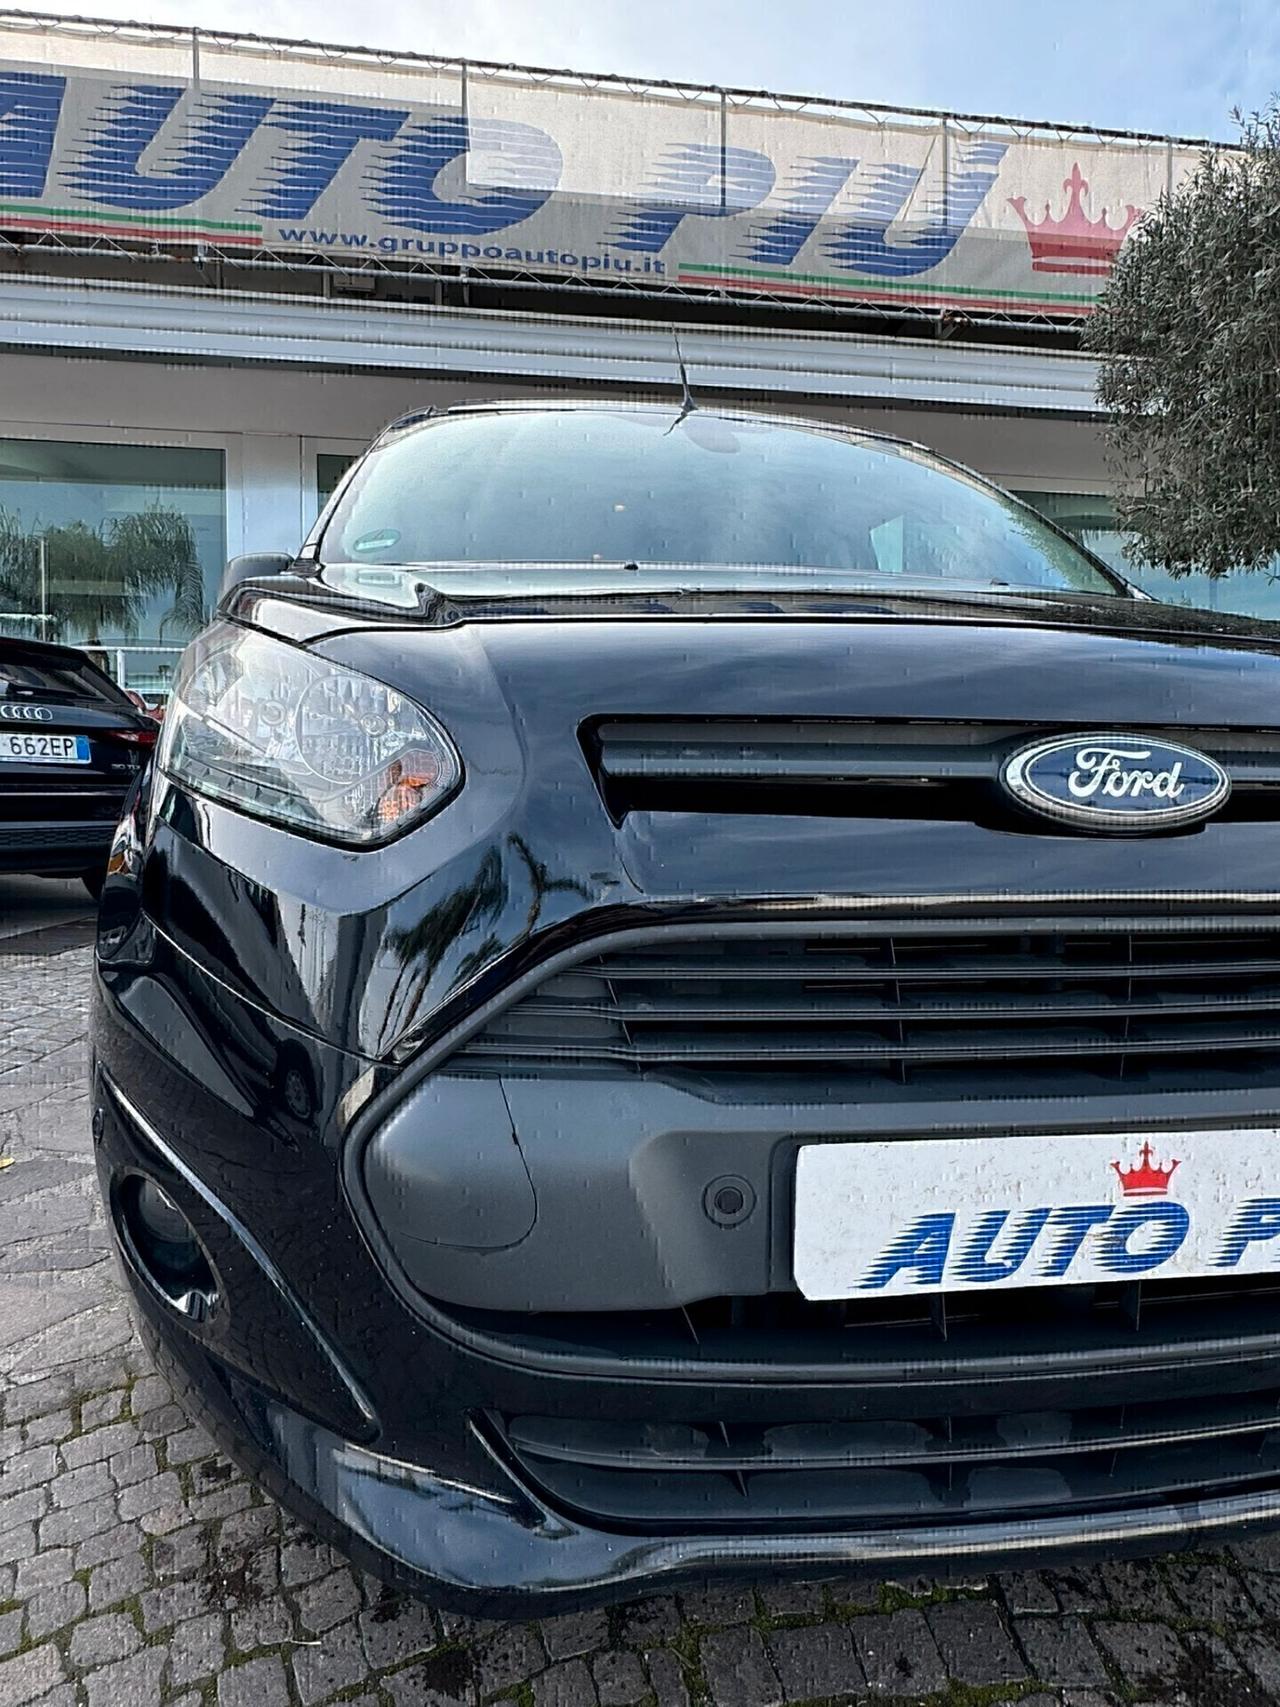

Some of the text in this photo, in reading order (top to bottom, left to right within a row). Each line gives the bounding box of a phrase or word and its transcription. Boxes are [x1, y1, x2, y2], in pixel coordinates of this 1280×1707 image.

[279, 228, 665, 274] www.gruppoautopiu.it
[10, 736, 74, 756] 662EP
[1068, 747, 1184, 798] Ford
[847, 1201, 1190, 1288] AUTO
